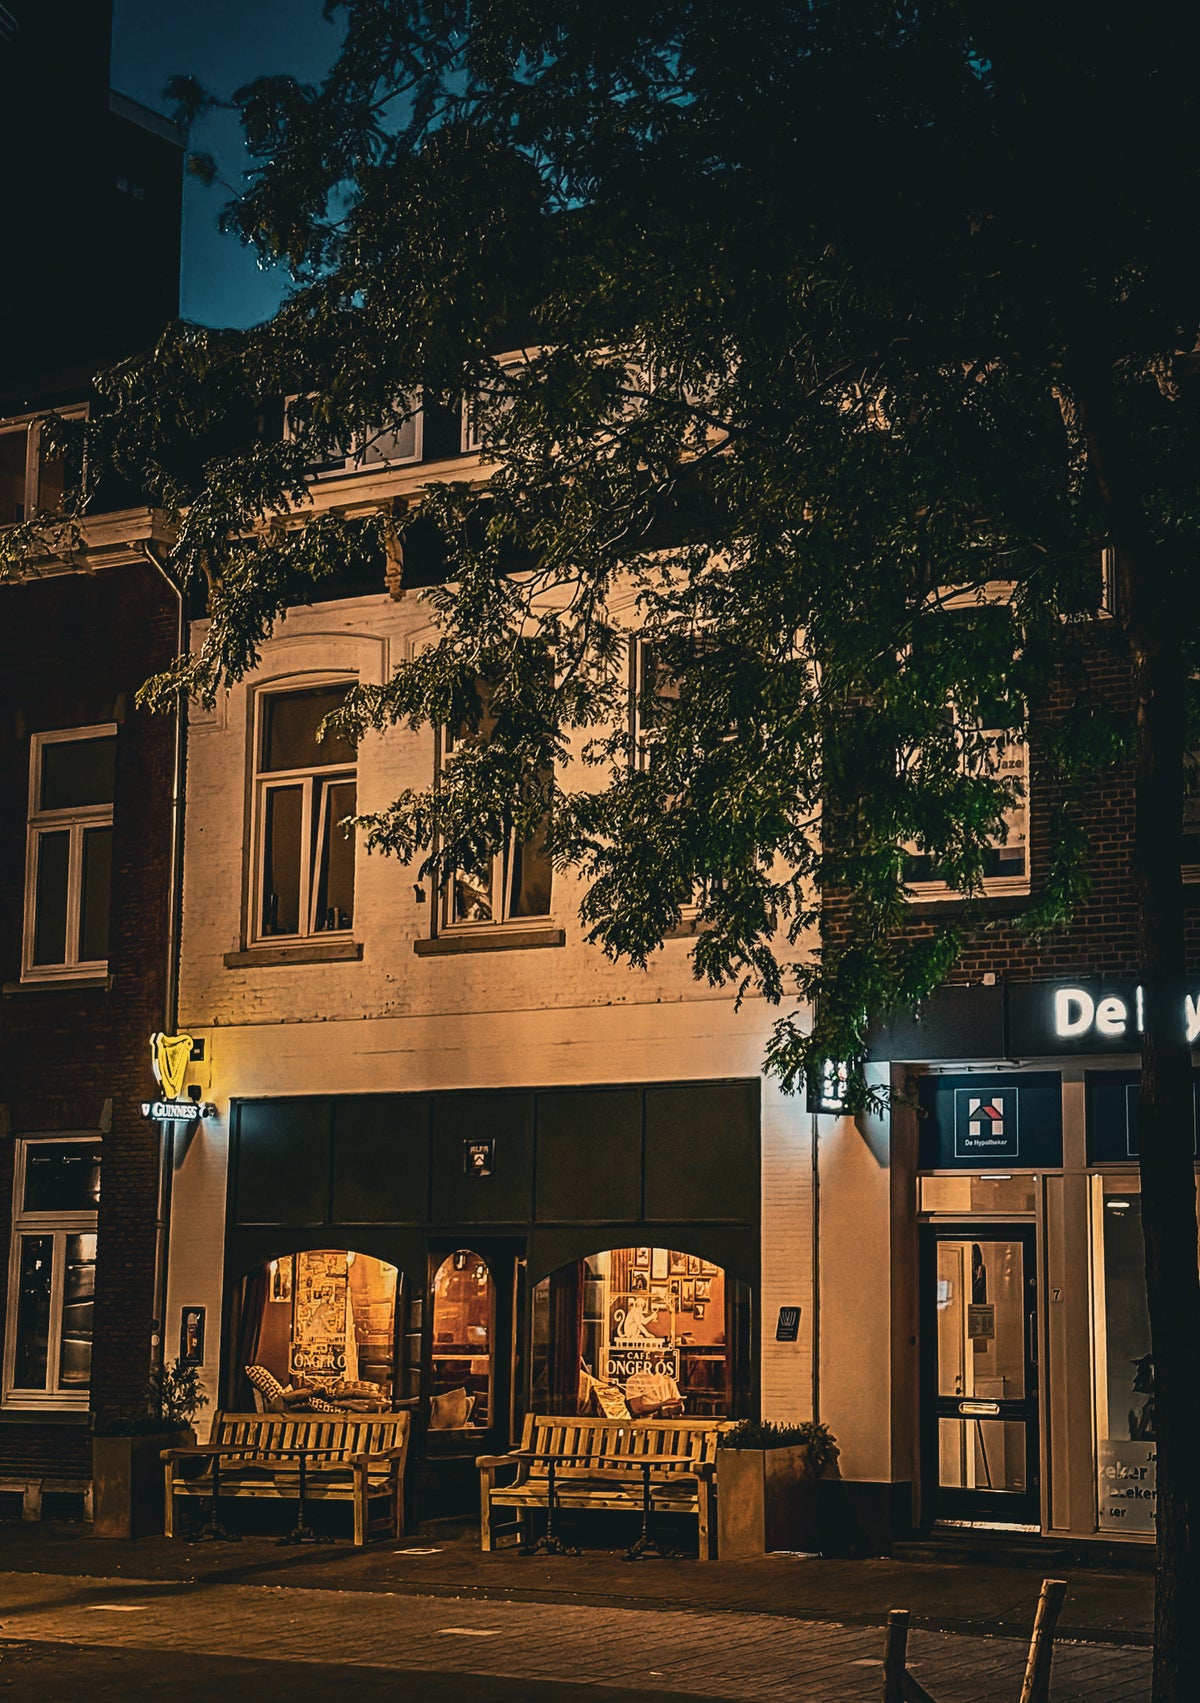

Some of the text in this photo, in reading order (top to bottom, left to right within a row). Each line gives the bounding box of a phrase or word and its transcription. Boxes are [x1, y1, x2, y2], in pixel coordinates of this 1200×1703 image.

[1055, 987, 1127, 1037] De
[152, 1102, 197, 1119] GUINNESS
[964, 1139, 973, 1147] De
[1053, 1289, 1061, 1300] 7
